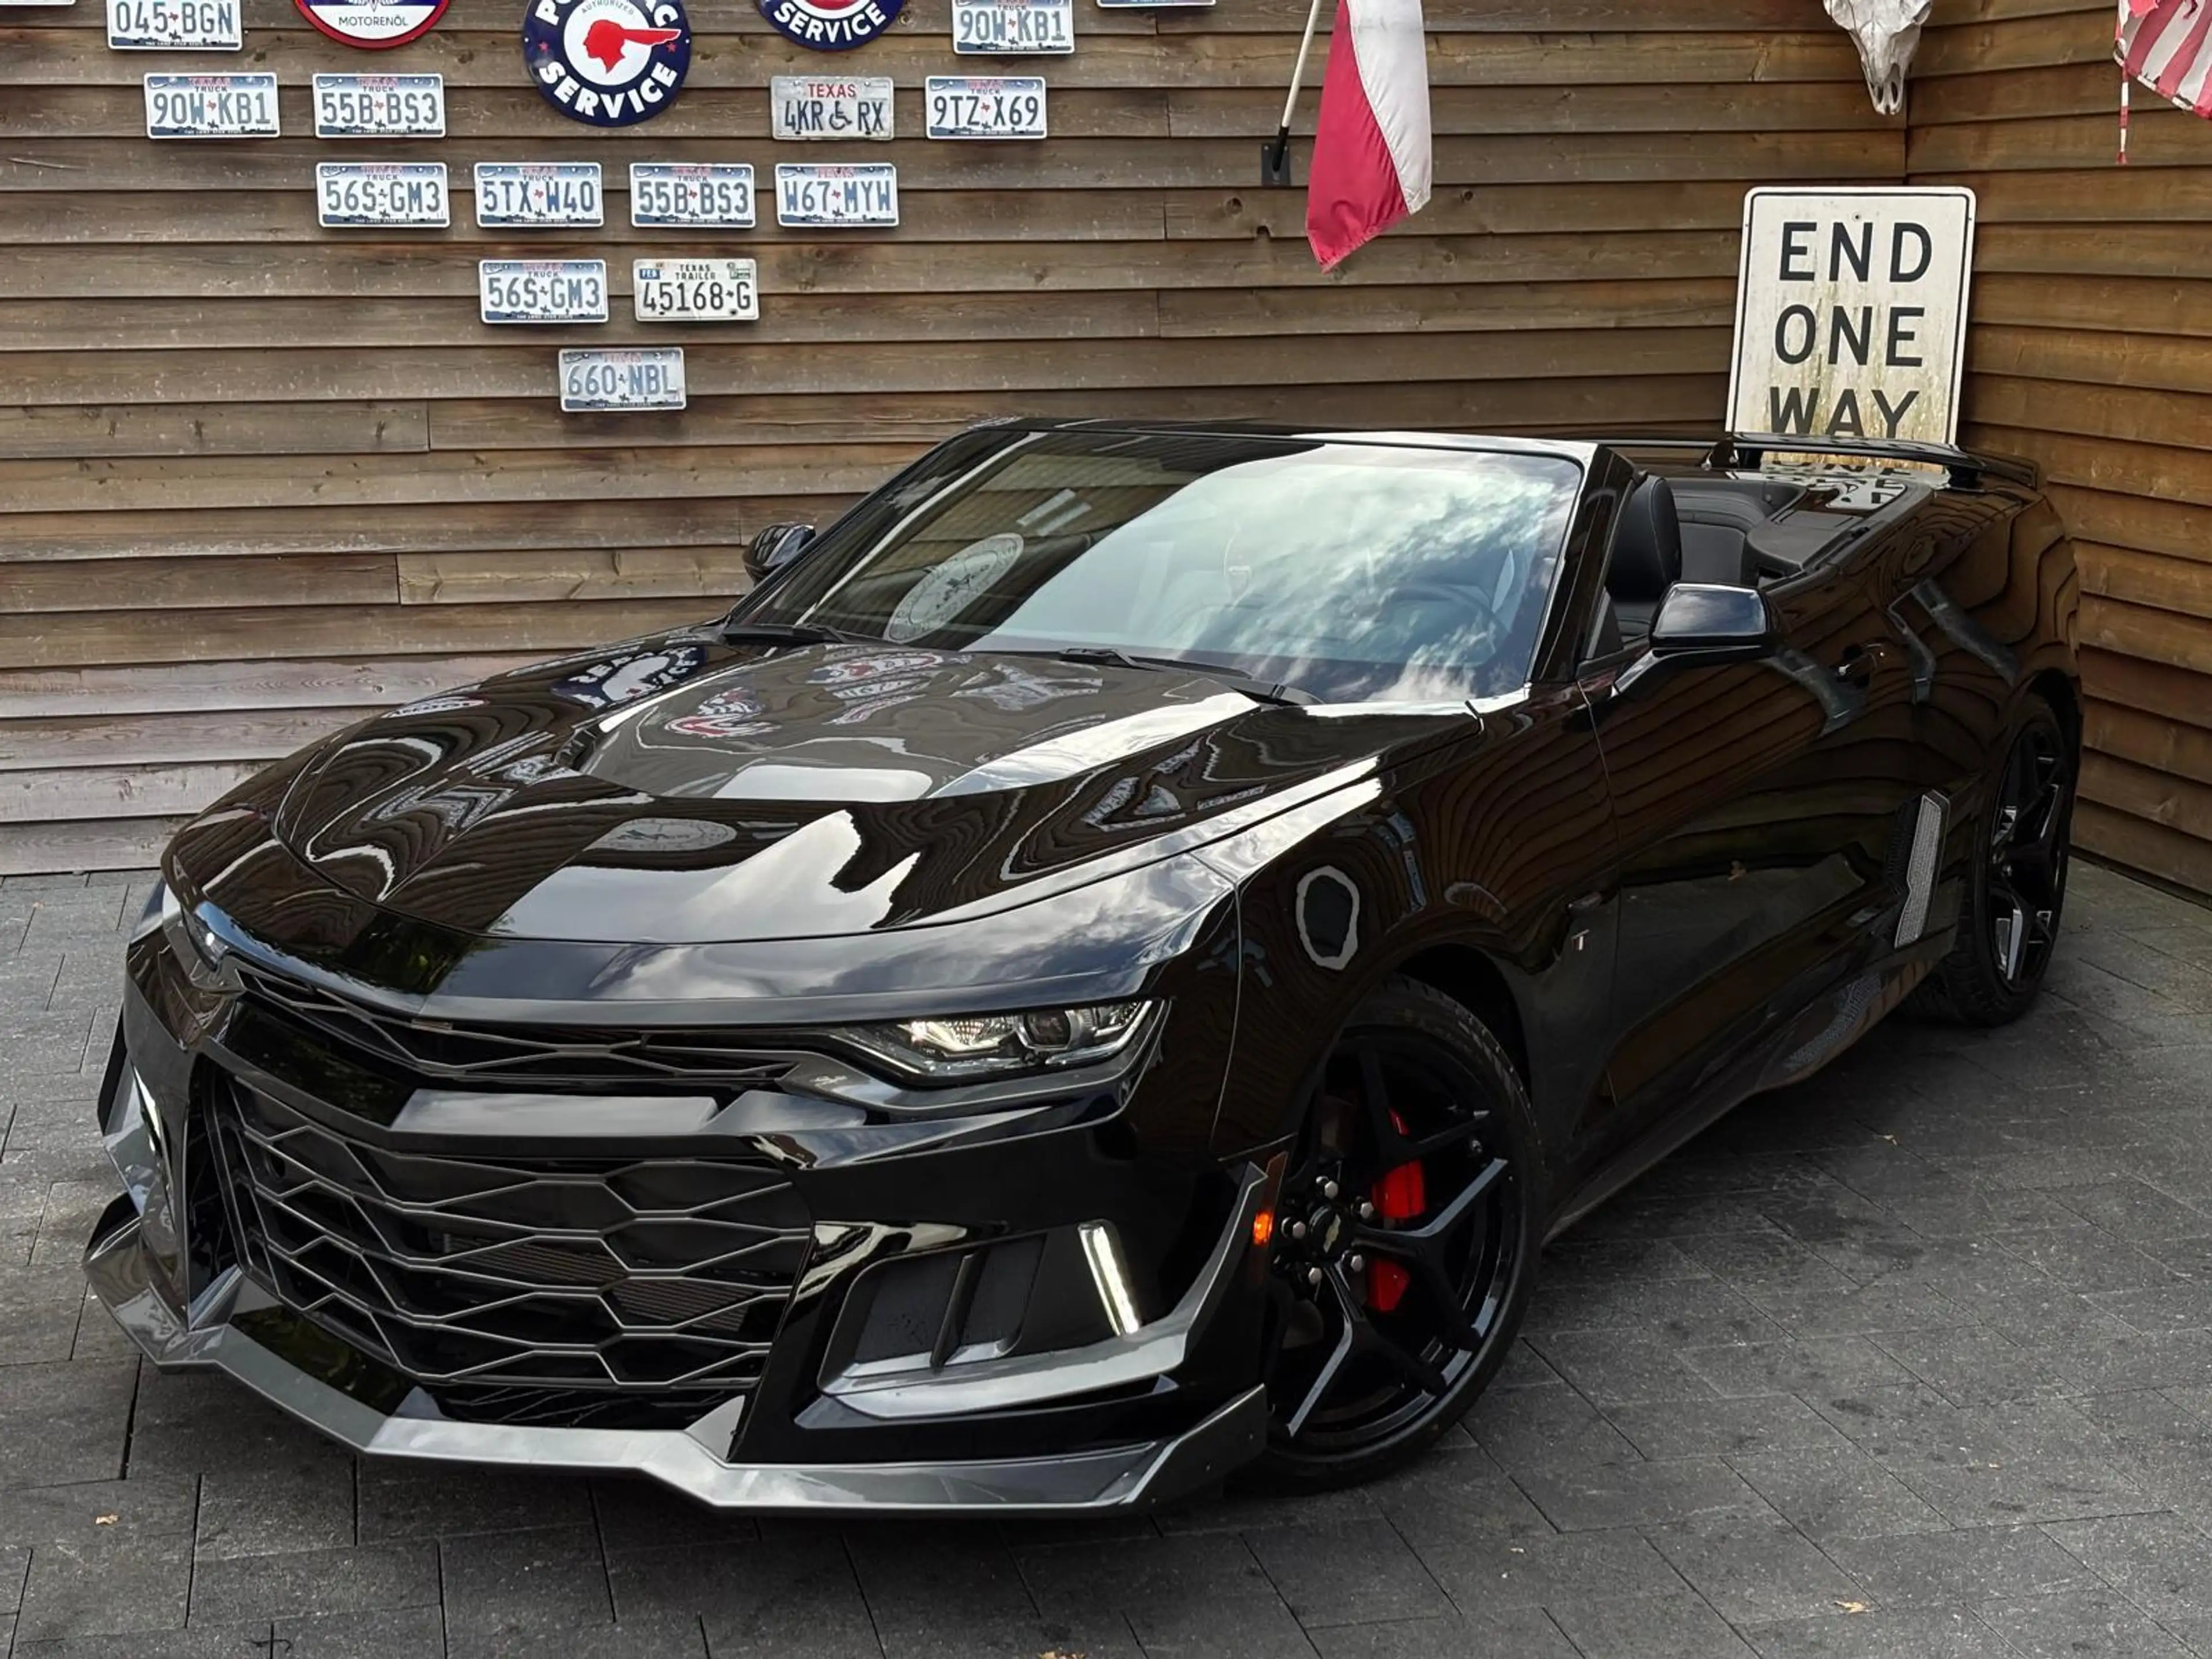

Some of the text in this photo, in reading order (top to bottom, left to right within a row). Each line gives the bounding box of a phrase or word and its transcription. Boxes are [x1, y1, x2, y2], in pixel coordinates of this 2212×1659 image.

[339, 15, 408, 26] MOTORENÖL
[773, 2, 887, 43] SERVICE
[539, 60, 678, 118] SERVICE
[808, 84, 857, 98] TEXAS
[785, 100, 884, 131] 4KR RX
[1779, 222, 1932, 282] END
[676, 272, 716, 281] TRAILER
[643, 282, 751, 311] 45168 G
[1775, 304, 1925, 366] ONE
[1770, 387, 1921, 438] WAY
